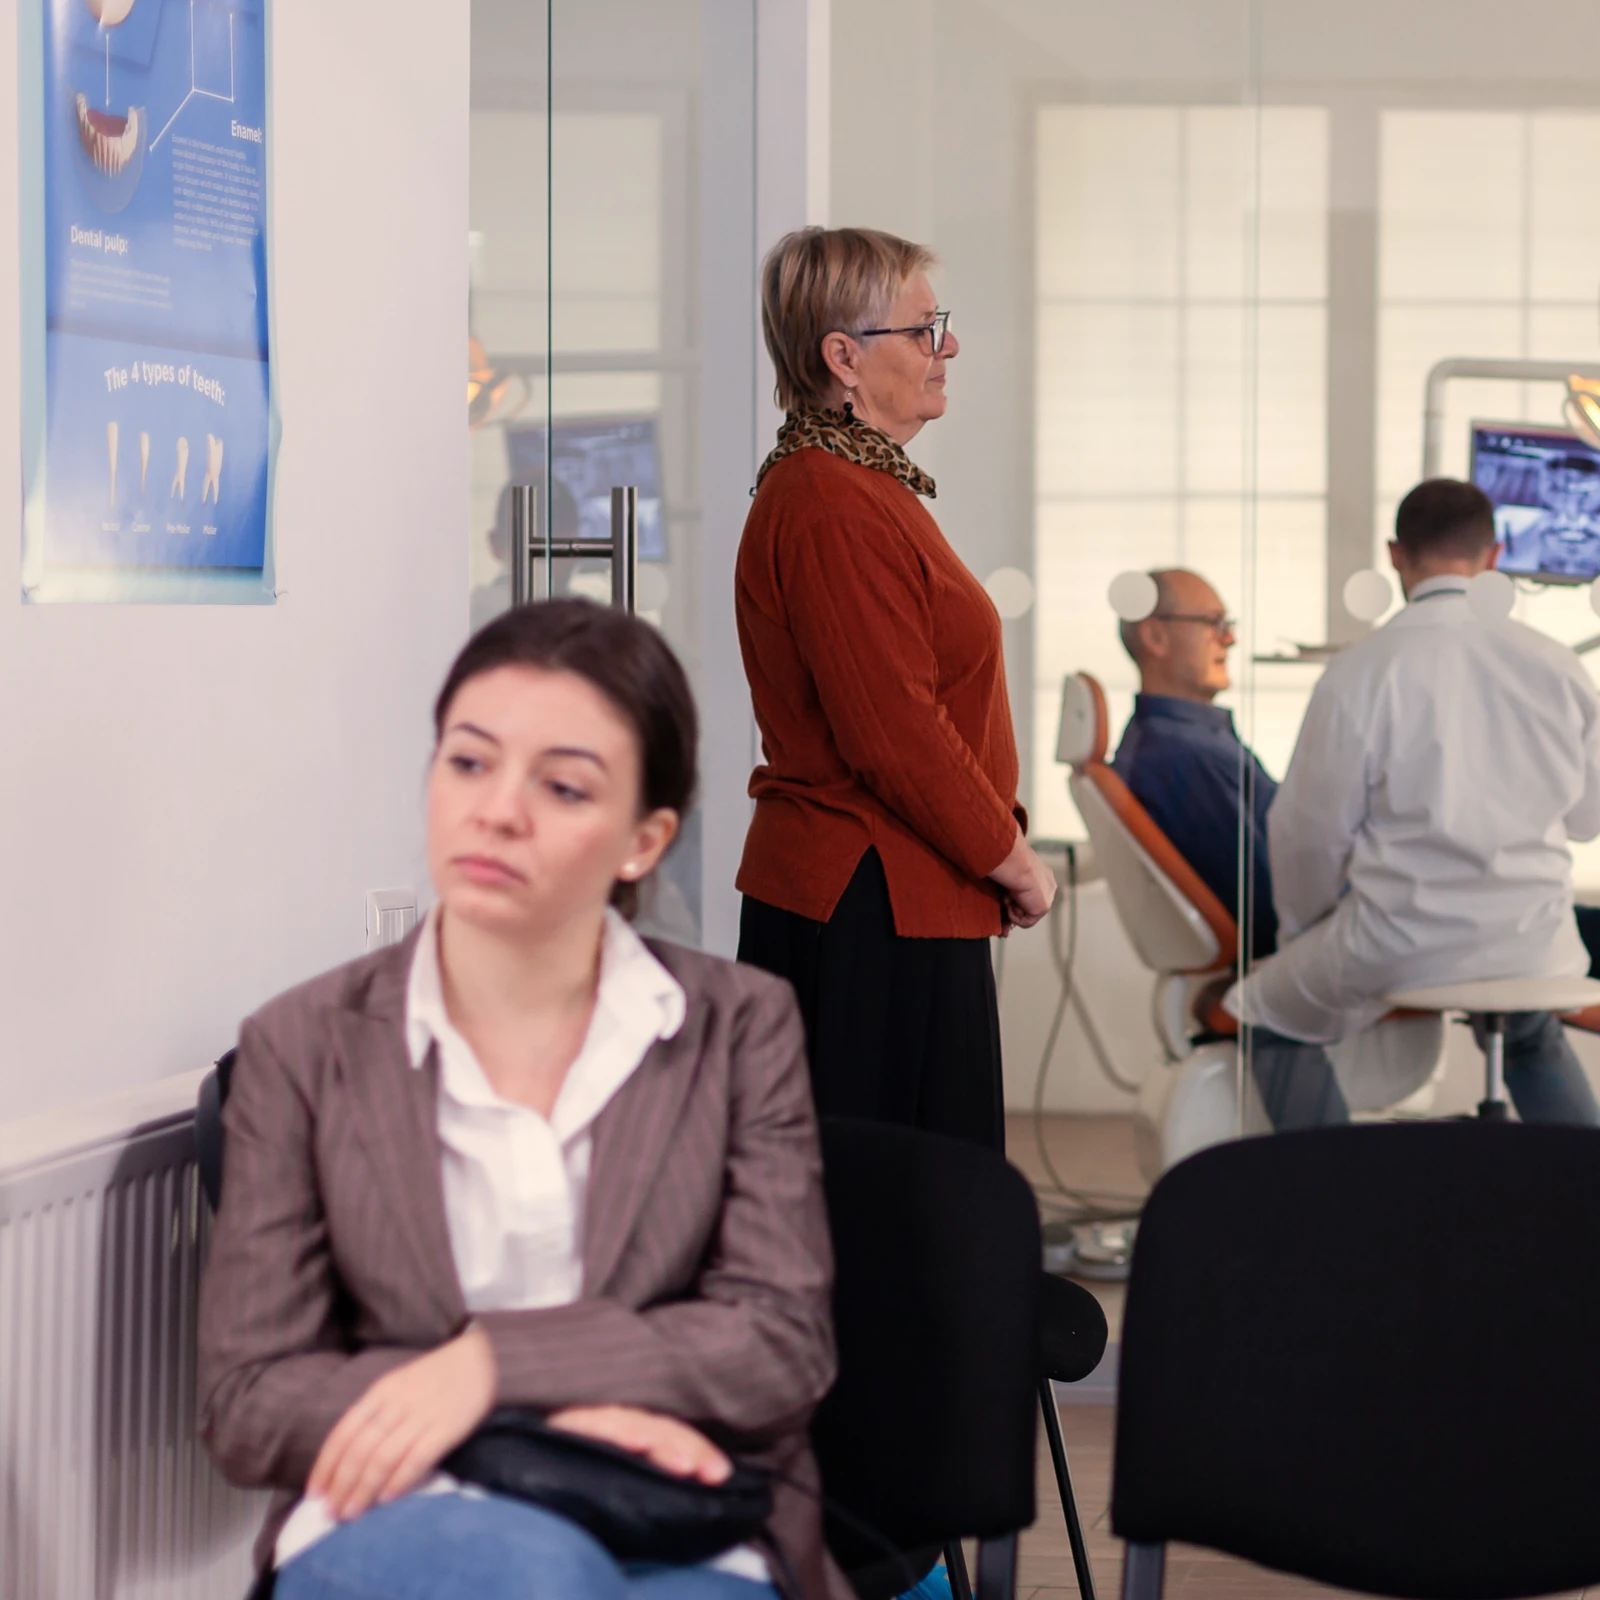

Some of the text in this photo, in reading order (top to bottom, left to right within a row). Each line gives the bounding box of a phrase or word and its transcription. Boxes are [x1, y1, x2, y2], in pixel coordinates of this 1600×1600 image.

[231, 120, 262, 143] Enamel:
[71, 226, 128, 256] Dental pulp:
[104, 361, 226, 406] The 4 types of teeth:
